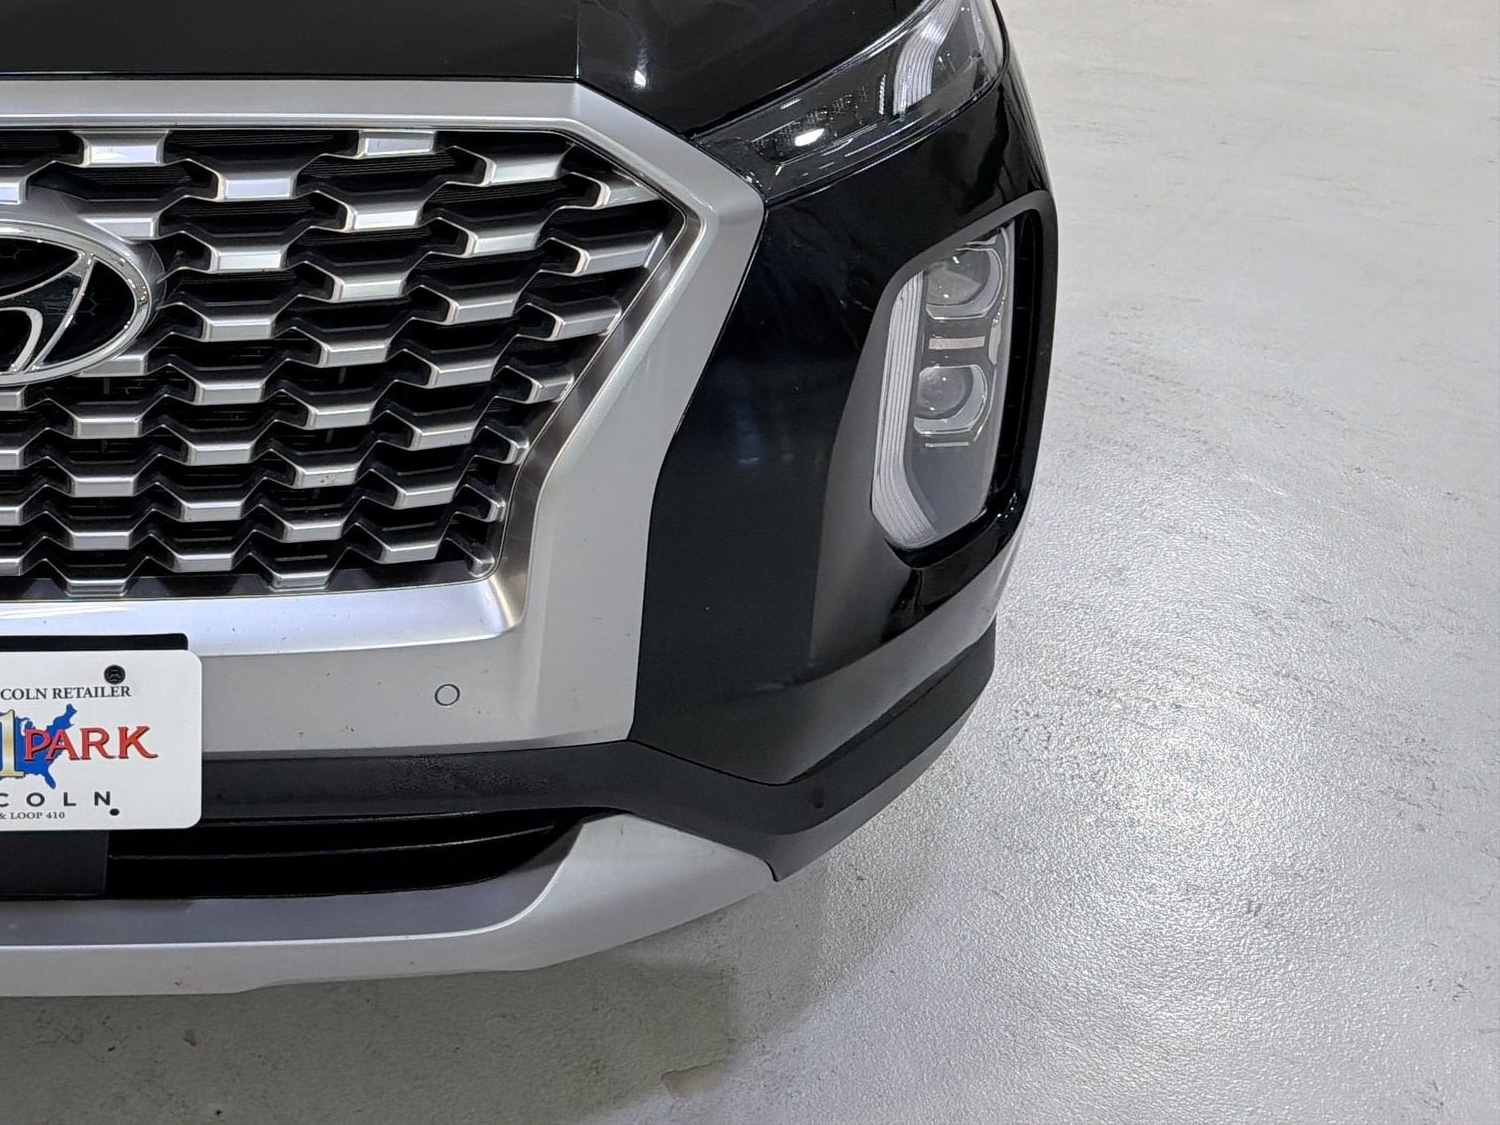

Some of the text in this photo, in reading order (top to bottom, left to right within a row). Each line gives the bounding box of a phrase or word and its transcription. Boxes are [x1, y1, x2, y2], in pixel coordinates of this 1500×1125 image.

[52, 685, 132, 699] RETAILER
[23, 725, 159, 762] PARK
[10, 811, 42, 820] LOOP
[45, 811, 65, 820] 410
